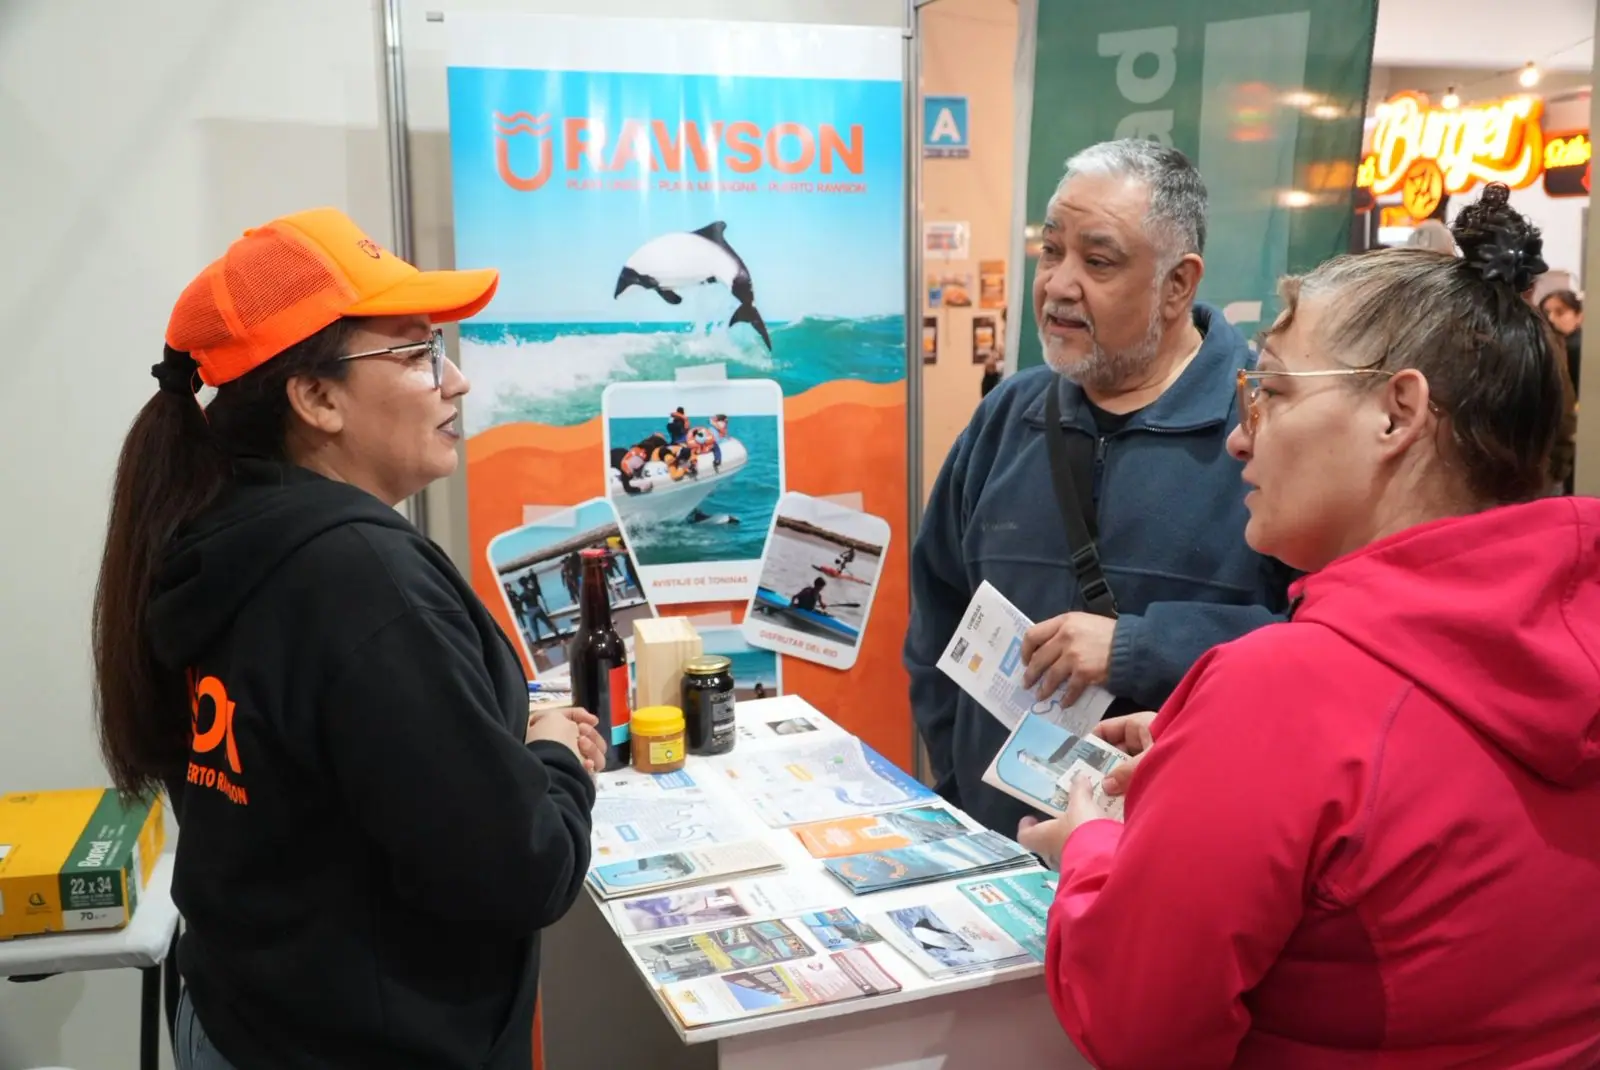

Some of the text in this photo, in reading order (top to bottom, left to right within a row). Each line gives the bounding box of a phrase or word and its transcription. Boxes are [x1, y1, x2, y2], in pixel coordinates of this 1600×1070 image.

[930, 107, 961, 142] A
[564, 117, 864, 175] RAWSON
[1369, 95, 1533, 192] Burger
[694, 576, 706, 586] DE
[70, 877, 86, 895] 22
[96, 876, 113, 894] 34
[80, 911, 94, 922] 70
